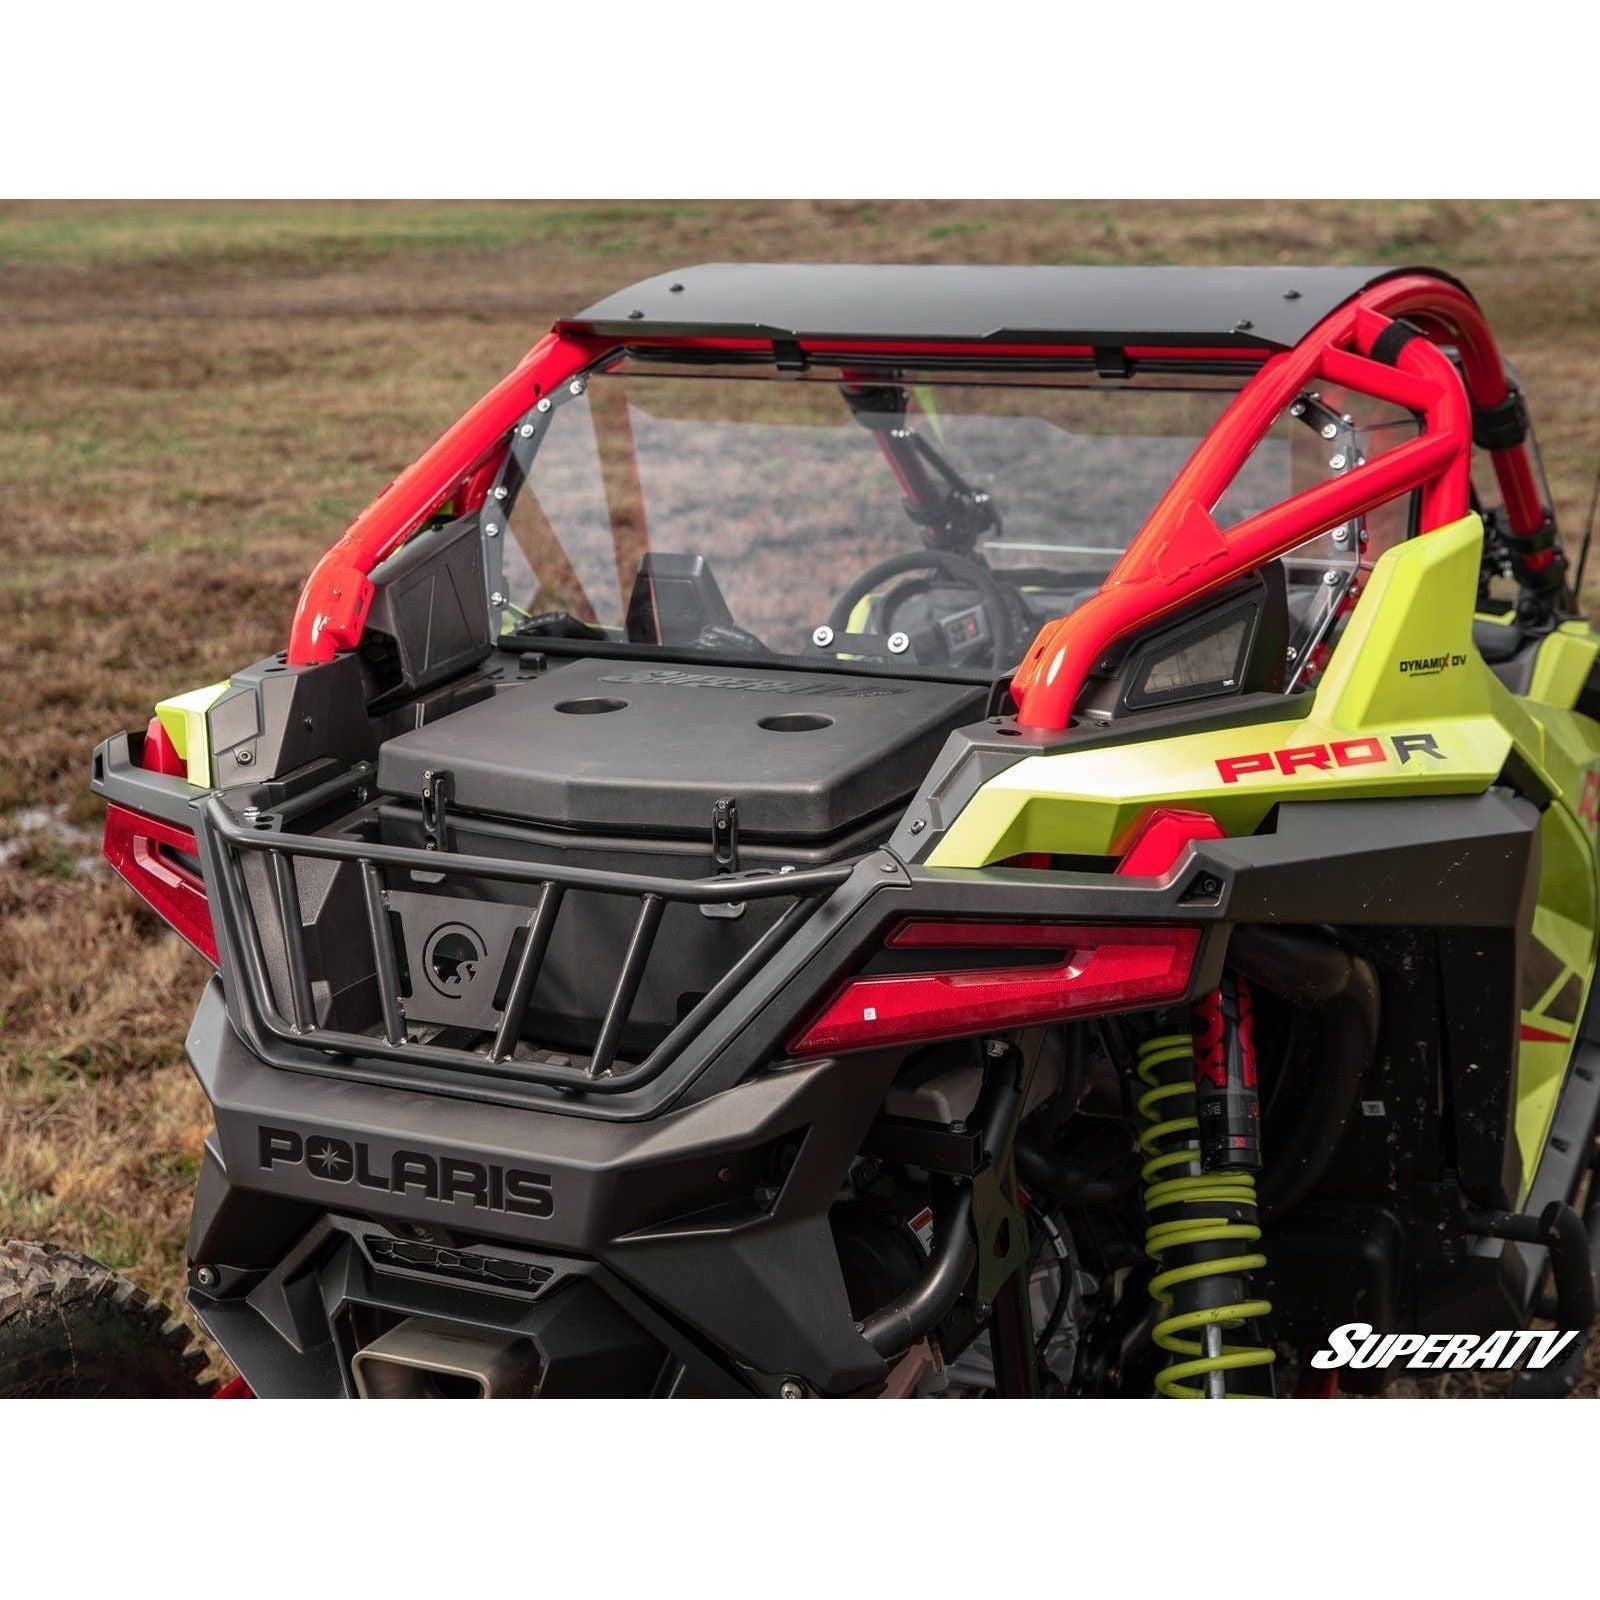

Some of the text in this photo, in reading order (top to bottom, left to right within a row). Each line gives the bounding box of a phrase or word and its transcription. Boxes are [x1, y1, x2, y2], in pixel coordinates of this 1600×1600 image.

[1399, 652, 1467, 672] DYNAMIX DV
[1215, 733, 1448, 784] PRO R
[257, 1125, 555, 1220] POLARIS
